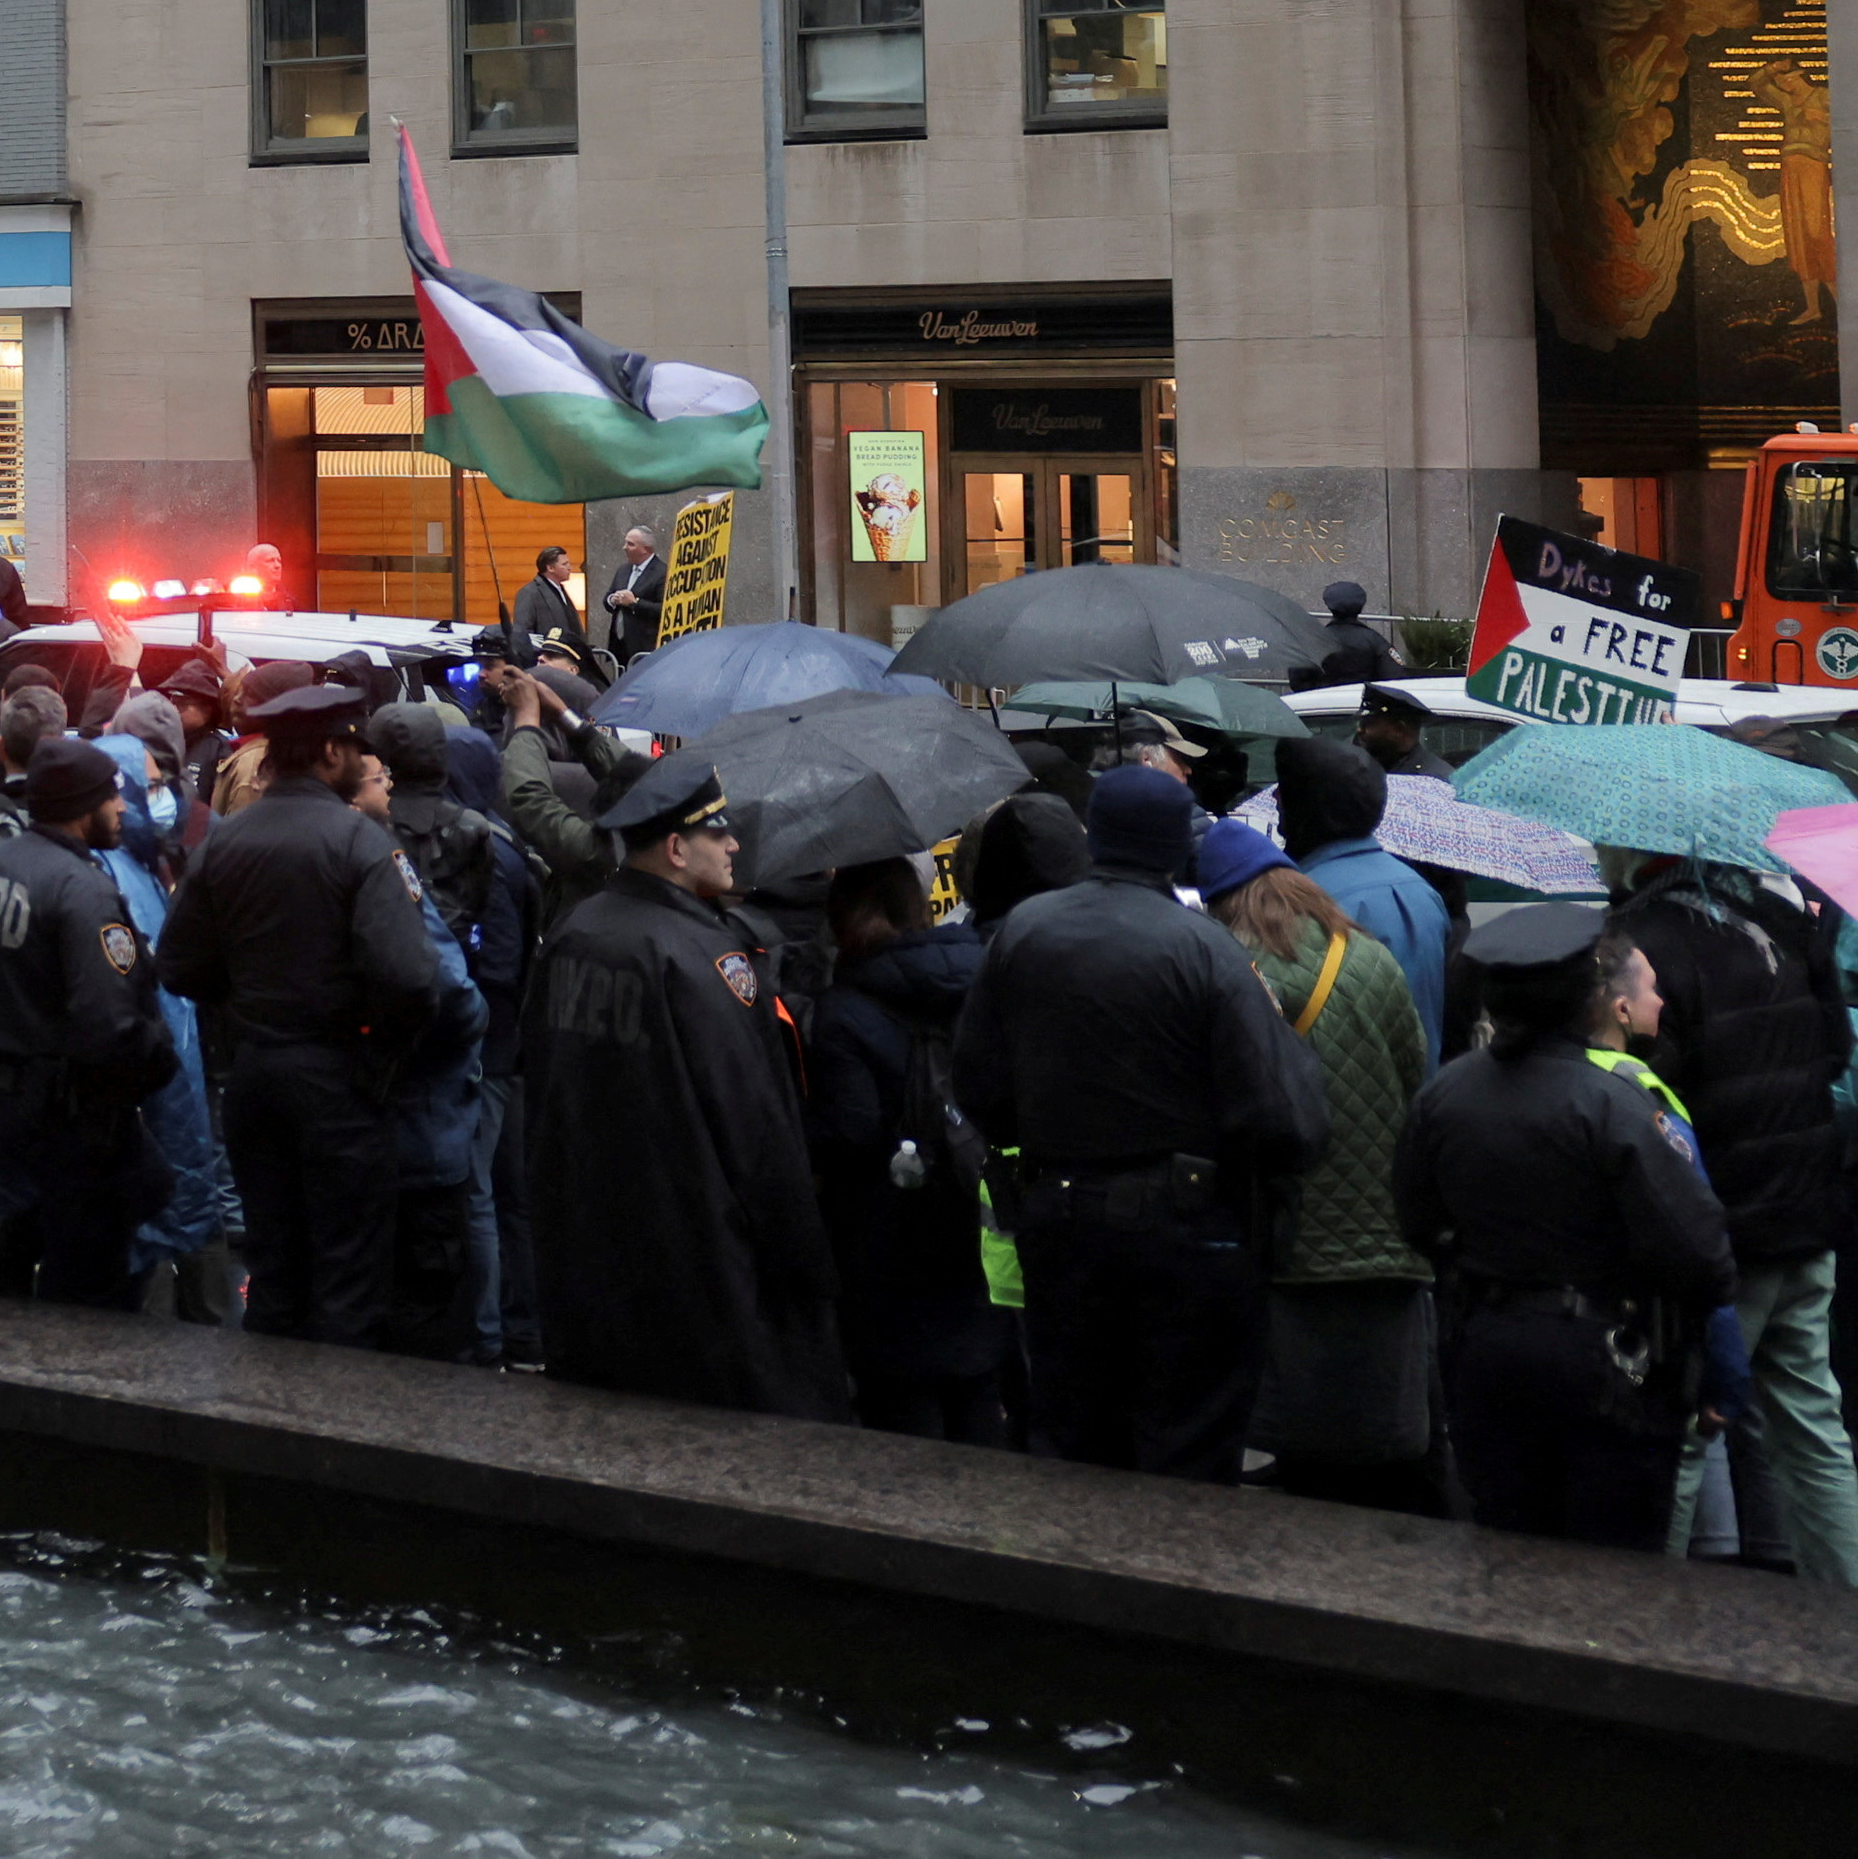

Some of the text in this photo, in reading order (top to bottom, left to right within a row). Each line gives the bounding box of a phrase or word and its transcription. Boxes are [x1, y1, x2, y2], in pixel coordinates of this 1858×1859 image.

[676, 498, 732, 543] RESISTANCE
[1219, 518, 1345, 540] COMCAST
[674, 528, 720, 570] AGAINST
[1220, 542, 1347, 564] BUILDING
[1538, 541, 1672, 612] Dykes for
[662, 604, 672, 633] IS
[673, 602, 684, 629] A
[1550, 616, 1677, 677] a FREE
